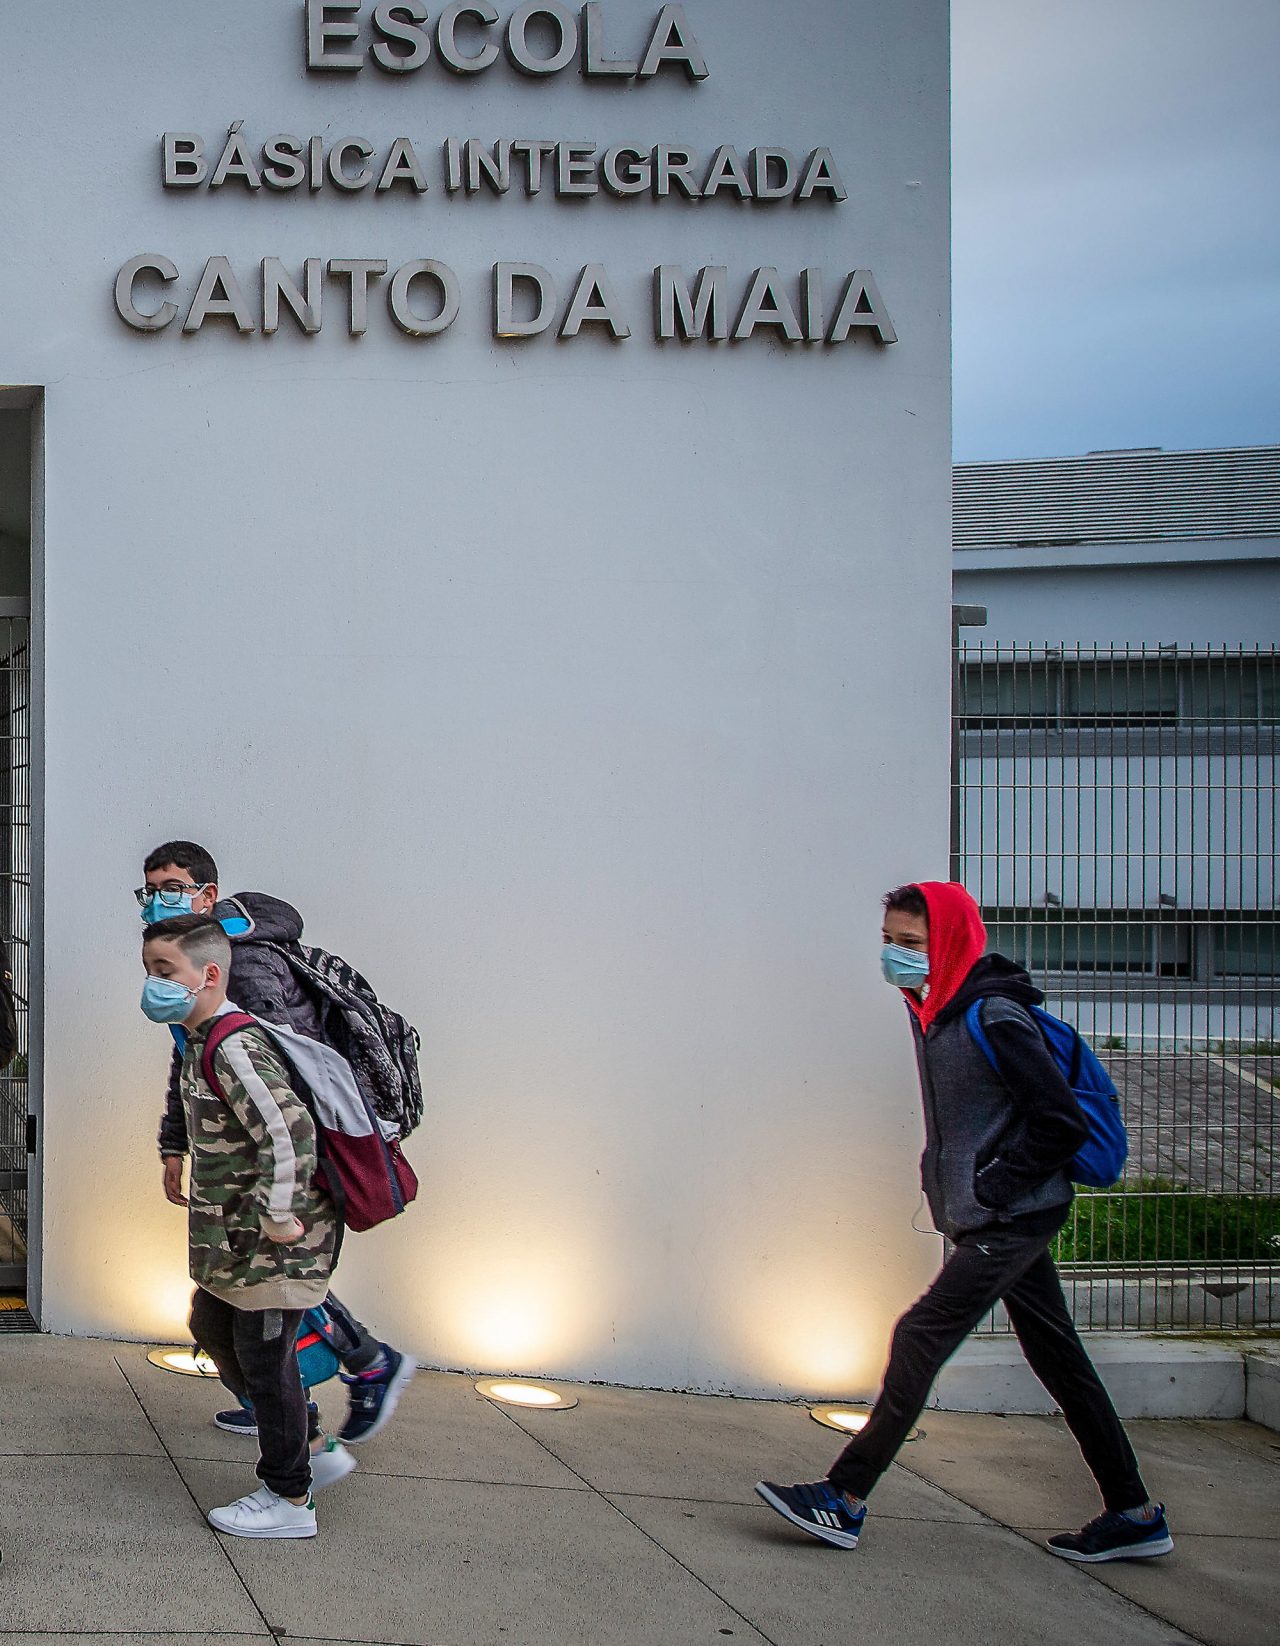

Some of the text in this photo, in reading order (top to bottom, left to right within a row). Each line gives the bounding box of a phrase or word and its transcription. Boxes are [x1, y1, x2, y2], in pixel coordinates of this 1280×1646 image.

[305, 0, 710, 81] ESCOLA
[161, 120, 848, 202] BÁSICA INTEGRADA
[114, 252, 899, 345] CANTO DA MAIA
